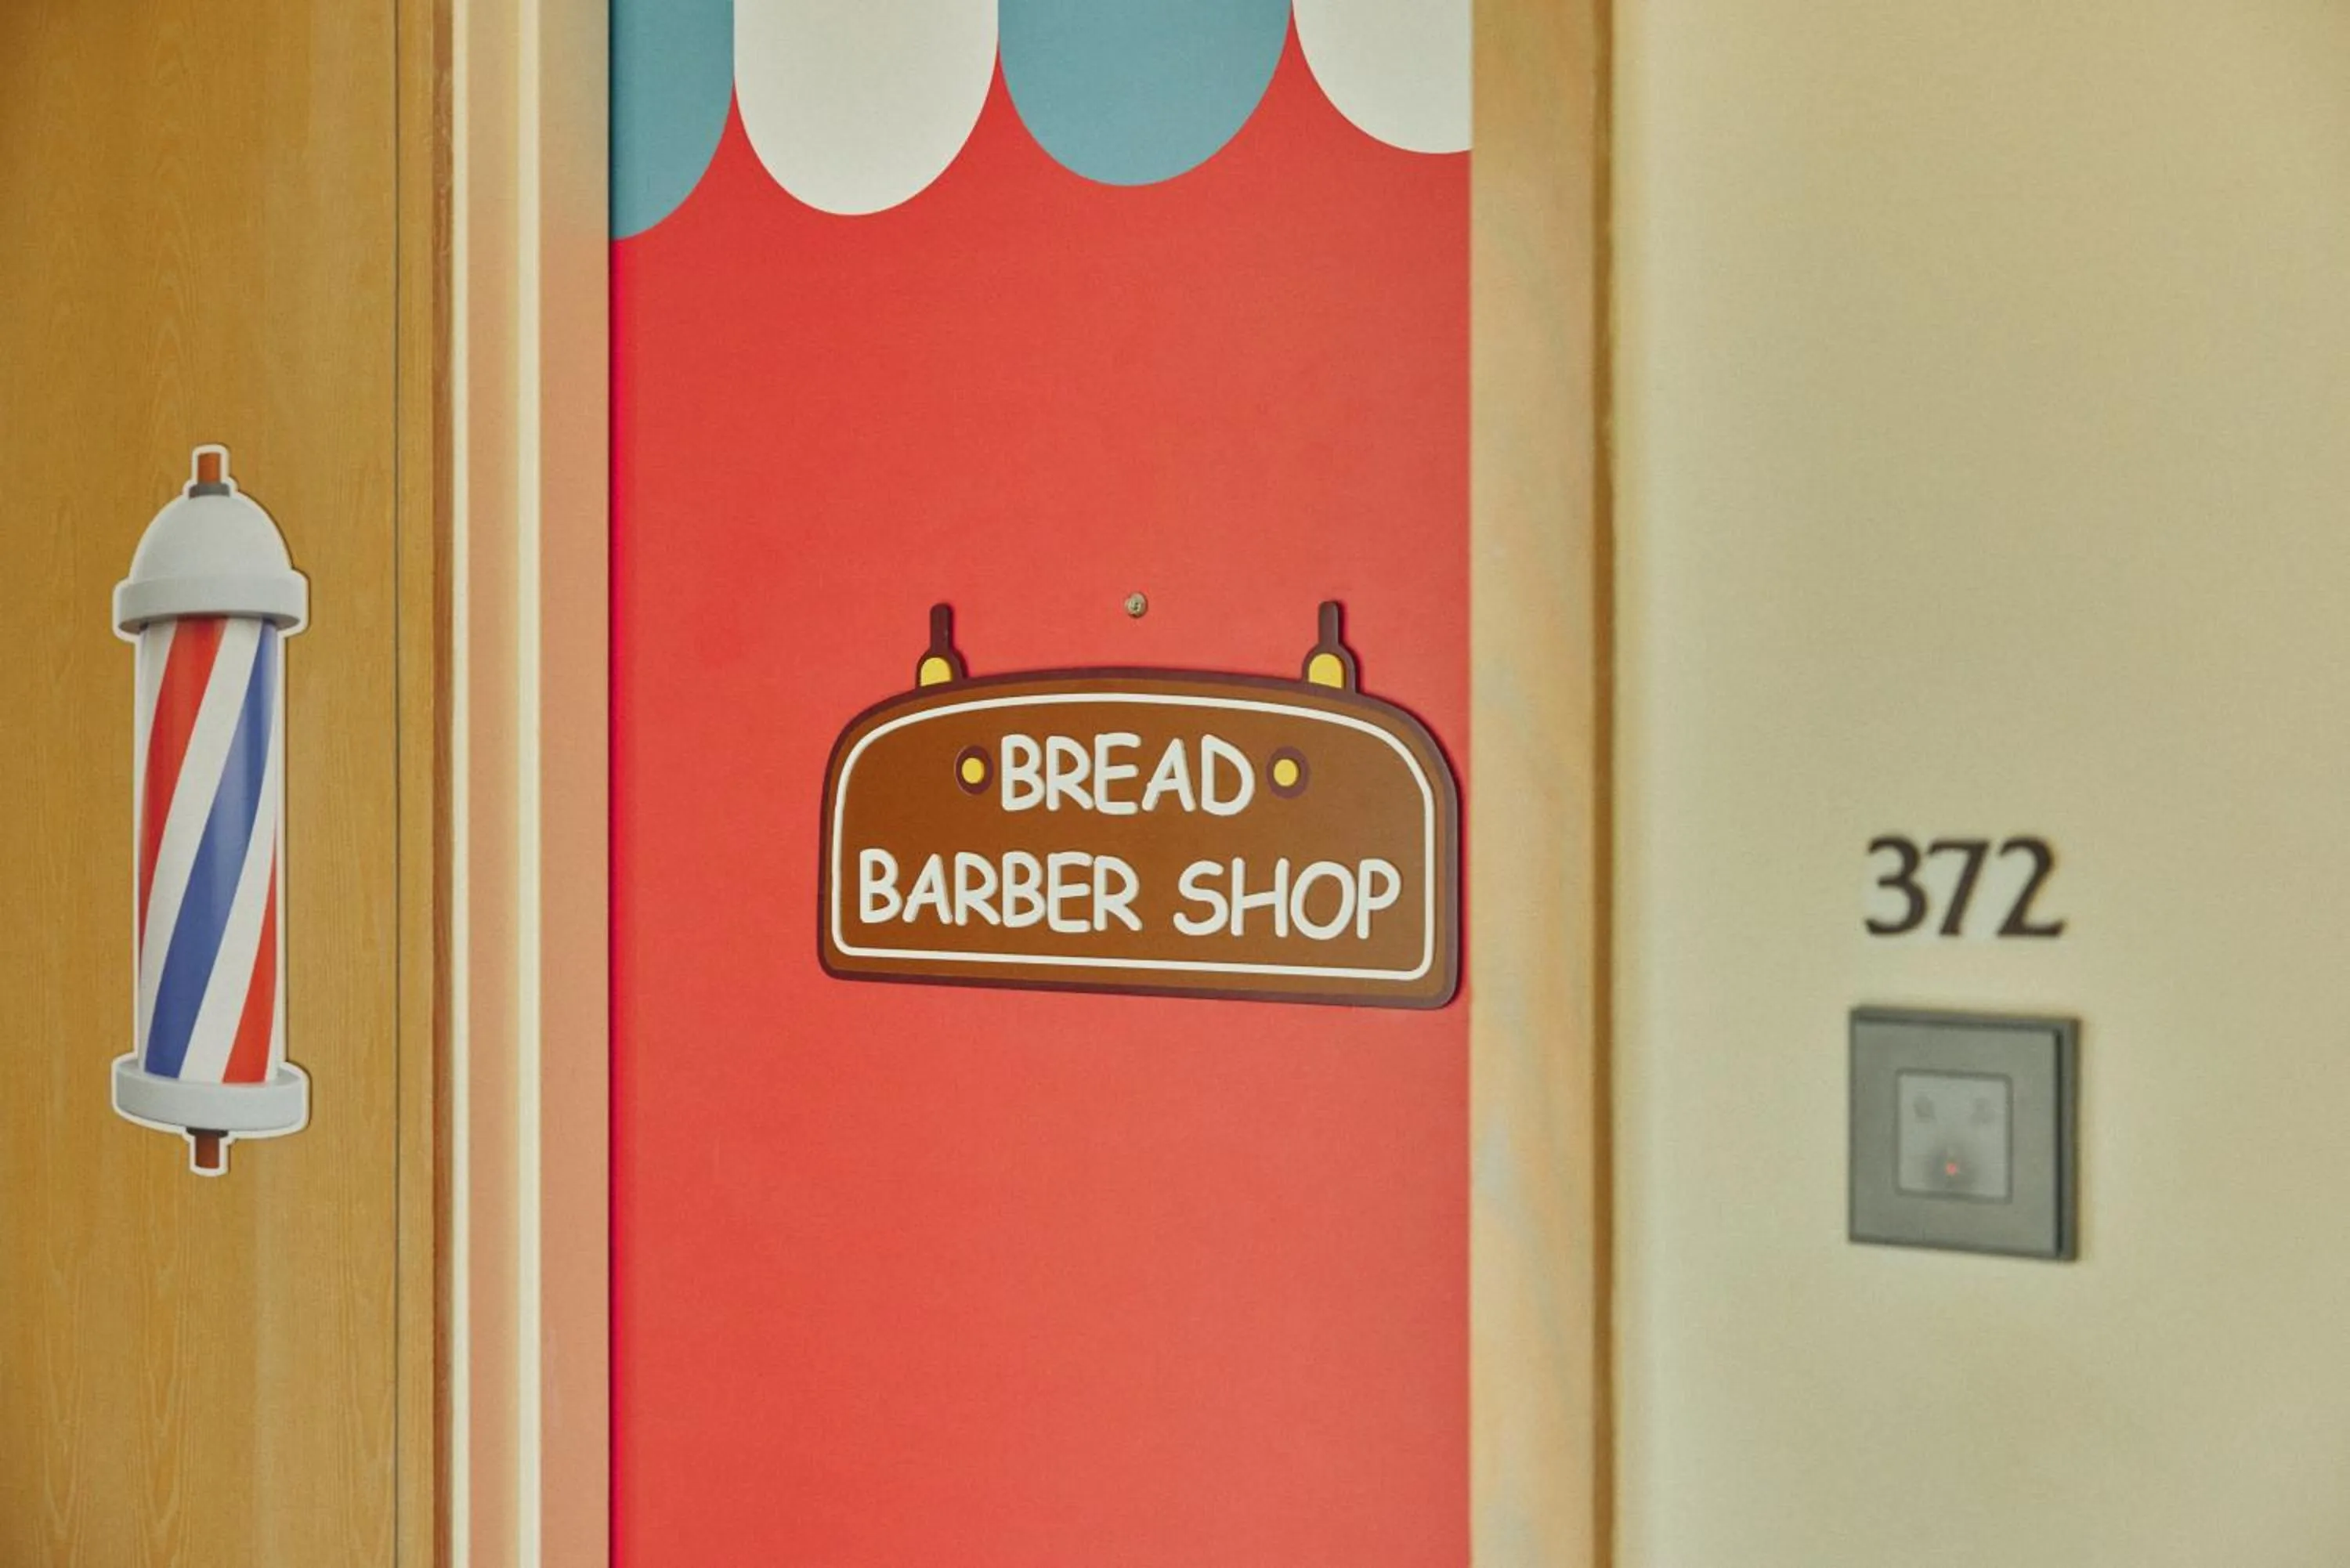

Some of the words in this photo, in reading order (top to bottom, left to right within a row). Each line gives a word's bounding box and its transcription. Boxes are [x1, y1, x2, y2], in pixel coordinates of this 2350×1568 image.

[1000, 732, 1255, 816] BREAD
[859, 848, 1142, 933] BARBER
[1173, 858, 1401, 940] SHOP
[1864, 834, 2068, 938] 372
